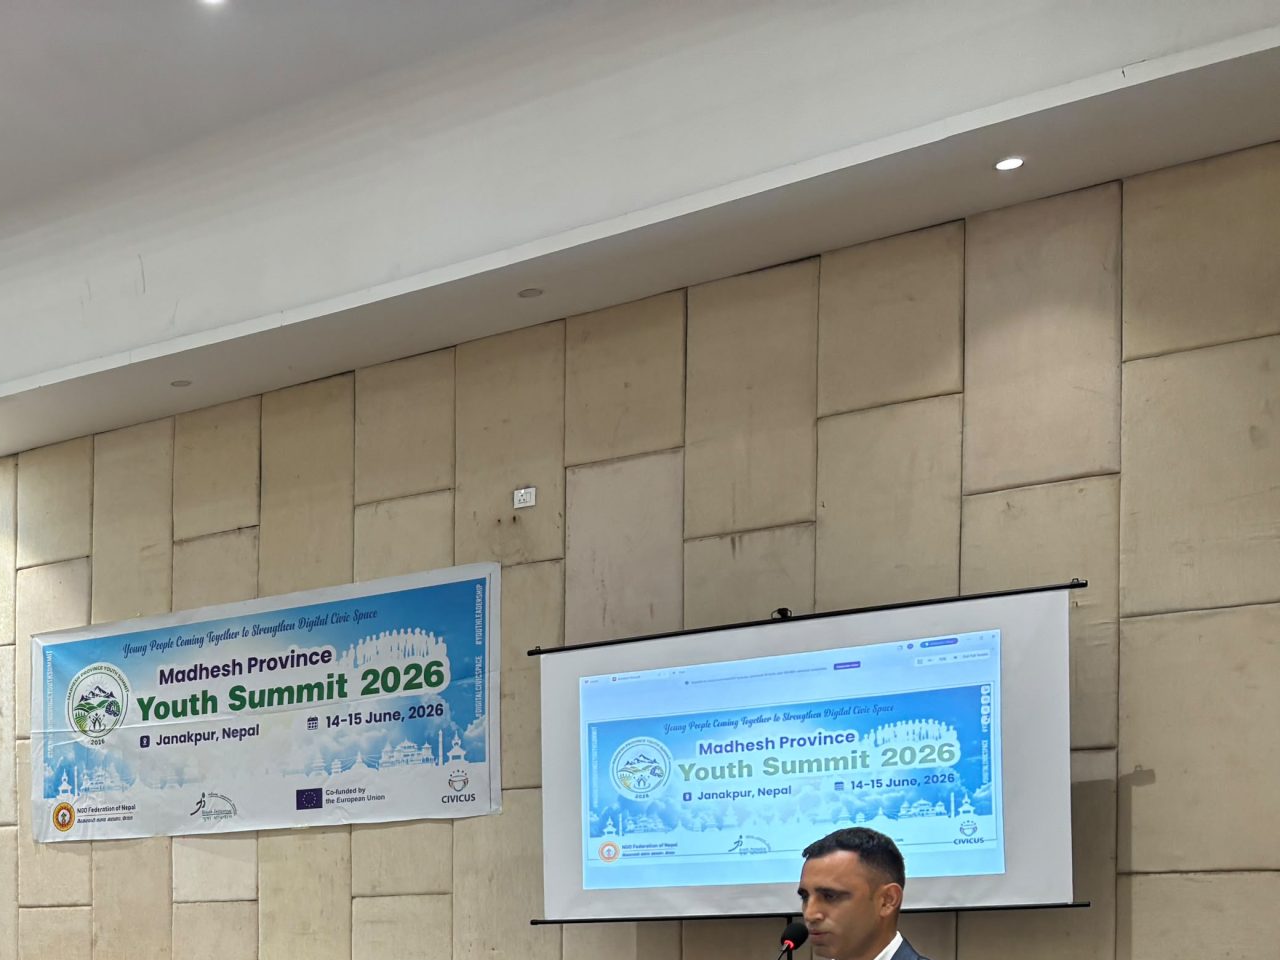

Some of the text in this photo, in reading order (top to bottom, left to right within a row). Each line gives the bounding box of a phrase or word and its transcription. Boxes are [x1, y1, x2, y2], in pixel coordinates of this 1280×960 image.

[122, 608, 378, 659] Young People Coming Together to Strengthen Digital Civic Space
[159, 649, 333, 686] Madhesh Province
[136, 660, 445, 721] Youth Summit 2026
[326, 703, 444, 729] 14-15 June, 2026
[664, 703, 894, 735] Young People Coming Together to Strengthen Digital Civic Space
[156, 723, 260, 746] Janakpur, Nepal
[699, 732, 856, 755] Madhesh Province
[678, 759, 753, 781] Youth
[763, 749, 870, 776] Summit
[881, 742, 956, 767] 2026
[325, 787, 366, 796] Co-funded by
[697, 785, 792, 801] Janakpur, Nepal
[851, 773, 955, 790] 14-15 June, 2026
[88, 805, 115, 813] Federation
[336, 796, 366, 804] European
[441, 793, 476, 804] CIVICUS
[953, 837, 985, 845] CIVICUS
